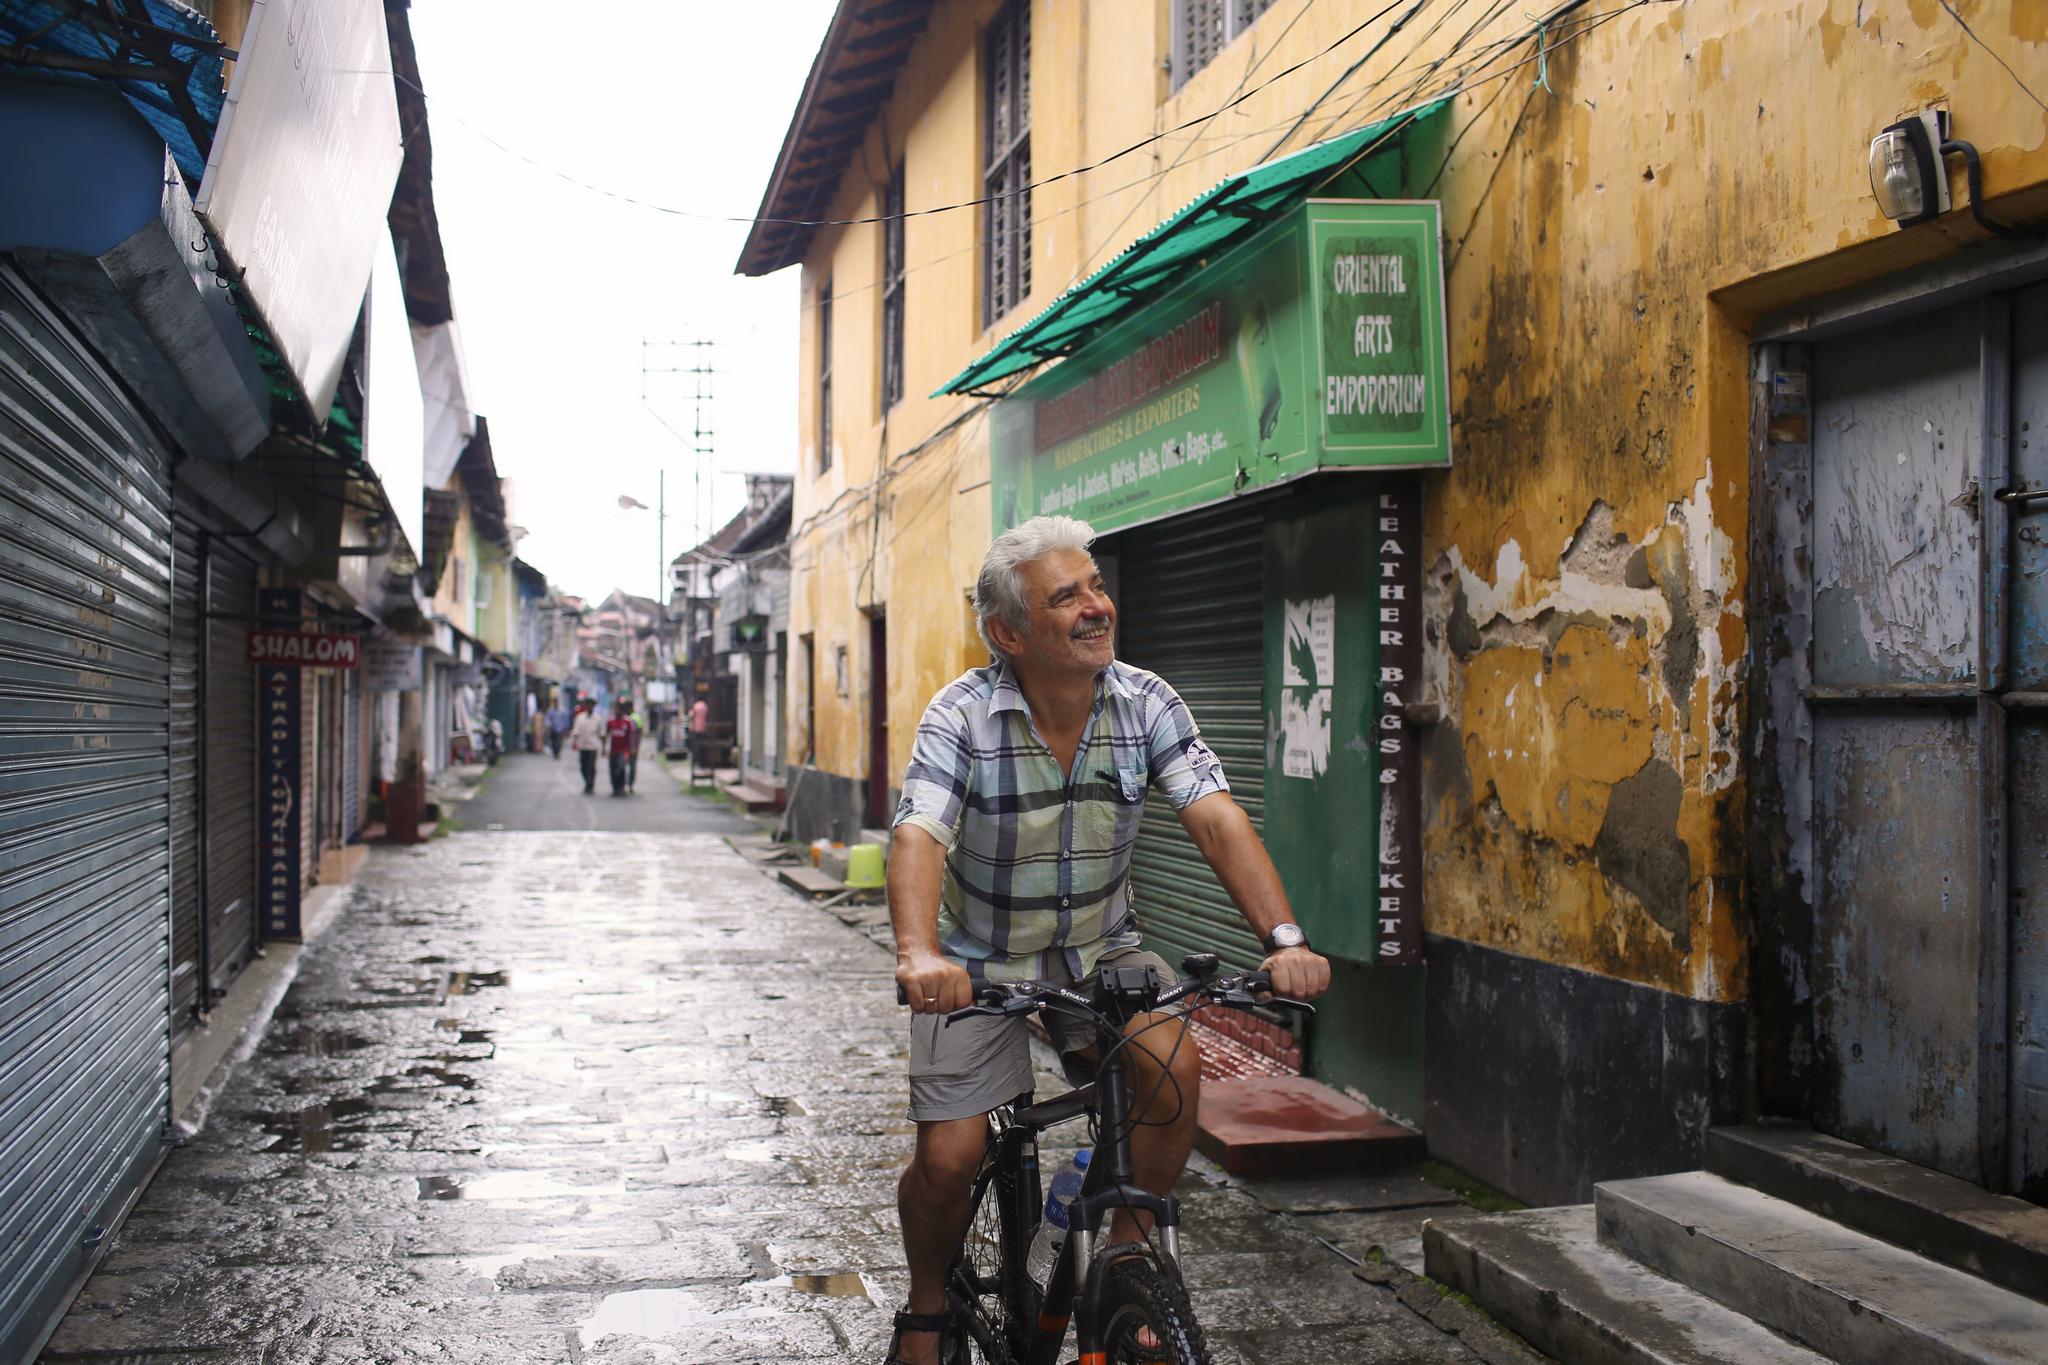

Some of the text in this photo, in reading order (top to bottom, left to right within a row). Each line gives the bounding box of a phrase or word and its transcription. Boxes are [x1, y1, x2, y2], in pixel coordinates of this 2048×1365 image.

[1333, 254, 1406, 297] ORIENTAL
[1133, 301, 1221, 401] EMPORIUM
[1354, 314, 1393, 358] ARTS
[1123, 414, 1134, 441] &
[1135, 383, 1201, 437] EXPORTERS
[1326, 375, 1426, 417] EMPOPORIUM
[1186, 430, 1210, 466] Bags,
[250, 634, 356, 663] SHALOM
[1379, 494, 1405, 957] LEATHER BAGS & CKETS
[271, 686, 288, 842] TRADITIONAL
[271, 847, 288, 930] SAREES
[1065, 991, 1091, 1005] GIANT
[1161, 986, 1184, 1002] GIANT
